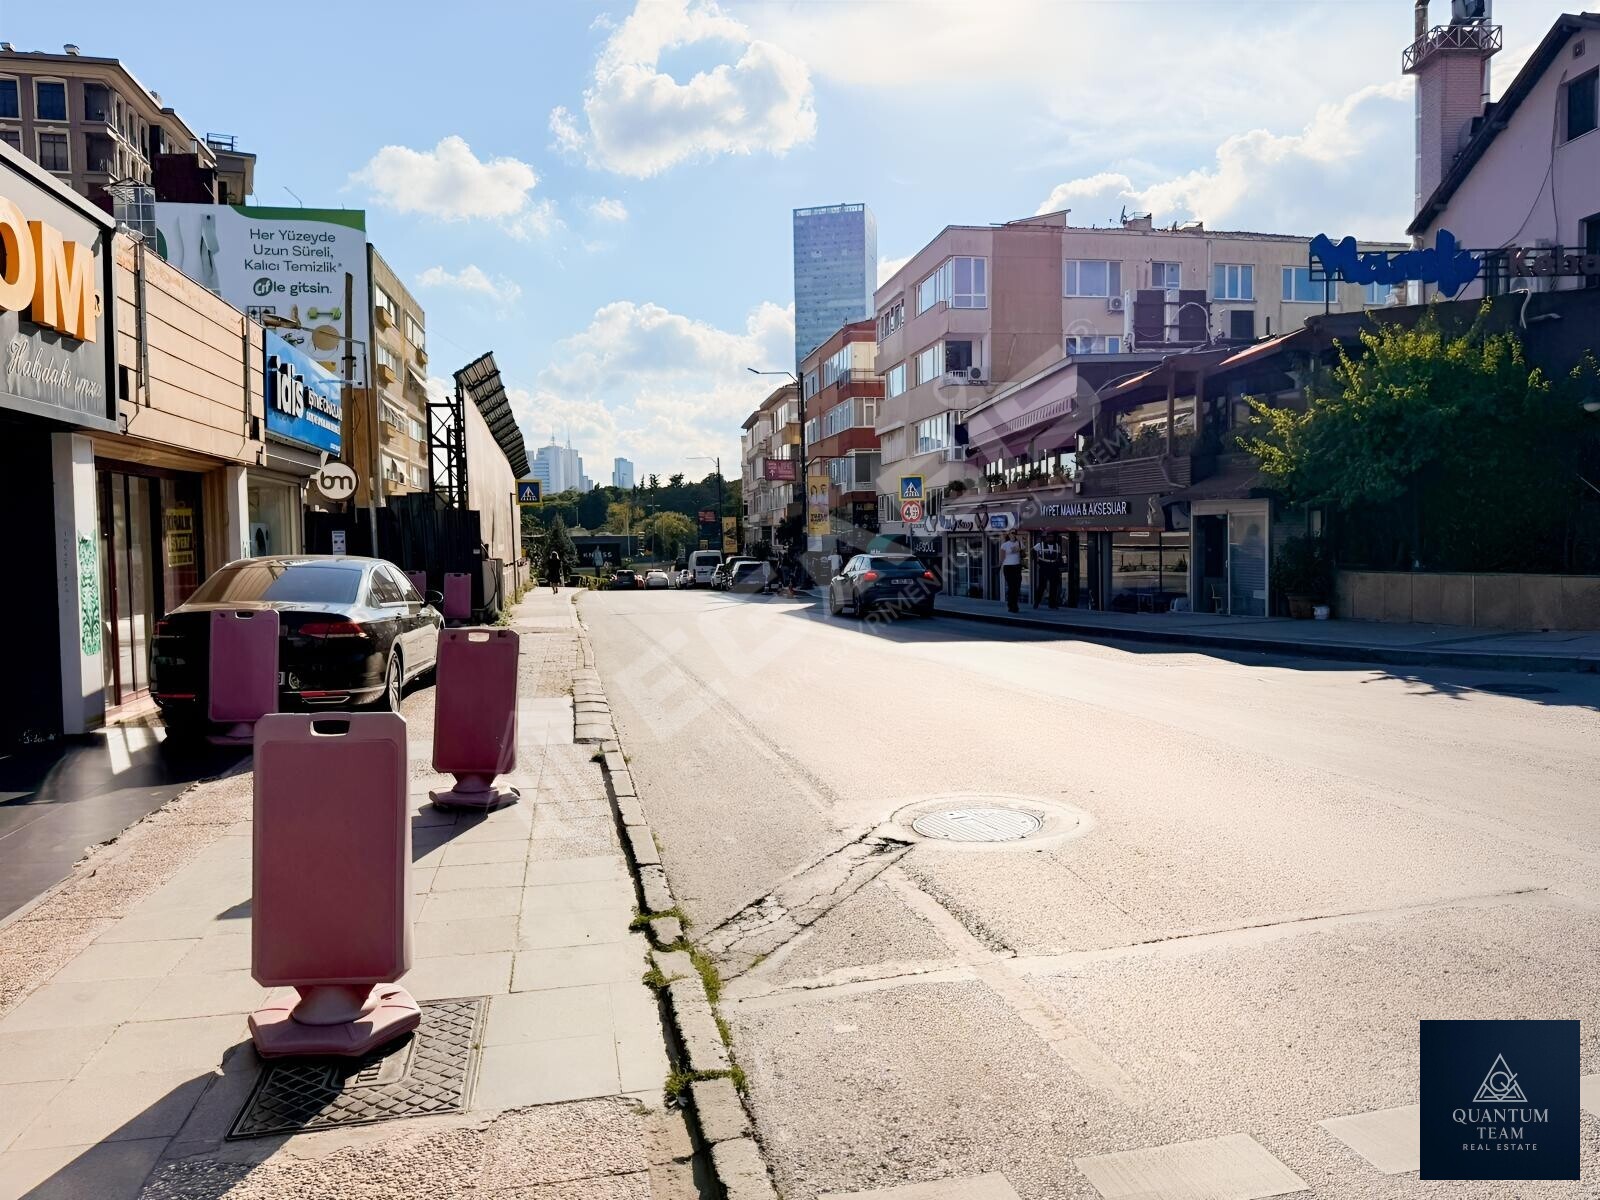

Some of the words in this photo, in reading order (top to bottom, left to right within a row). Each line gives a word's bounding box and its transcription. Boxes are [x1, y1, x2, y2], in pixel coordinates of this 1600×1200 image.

[250, 228, 275, 240] Her
[278, 229, 336, 245] Yüzeyde
[253, 244, 289, 256] Uzun
[292, 245, 334, 258] Süreli,
[244, 258, 280, 271] Kalıcı
[290, 281, 333, 296] gitsin.
[320, 470, 353, 490] bm
[1088, 501, 1127, 515] AKSESUAR
